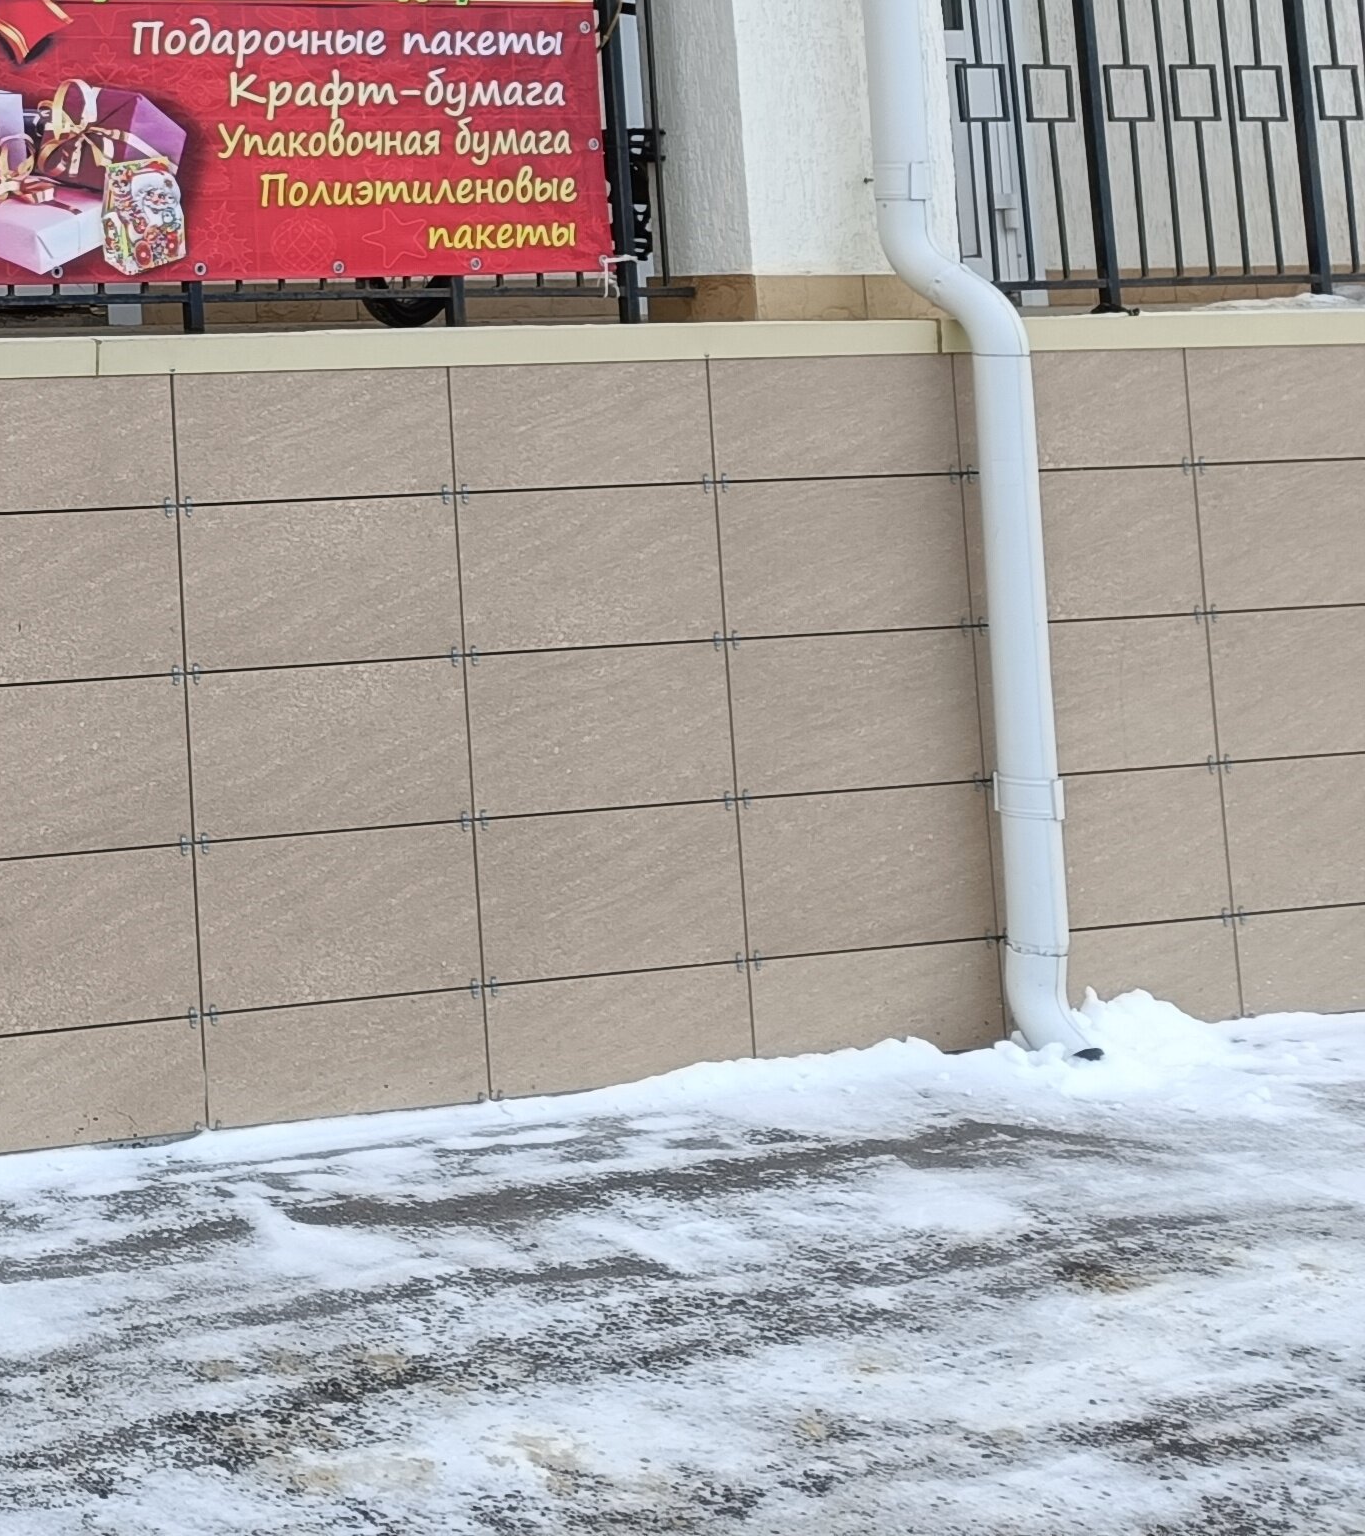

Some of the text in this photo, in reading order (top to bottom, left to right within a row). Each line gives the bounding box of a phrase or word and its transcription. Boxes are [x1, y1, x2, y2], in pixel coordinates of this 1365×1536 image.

[132, 19, 563, 66] Подарочные пакеты
[229, 68, 566, 120] Крафт-бумага
[217, 119, 573, 165] Упаковочная бумага
[260, 165, 578, 208] Полиэтиленовые
[427, 220, 577, 250] пакеты
